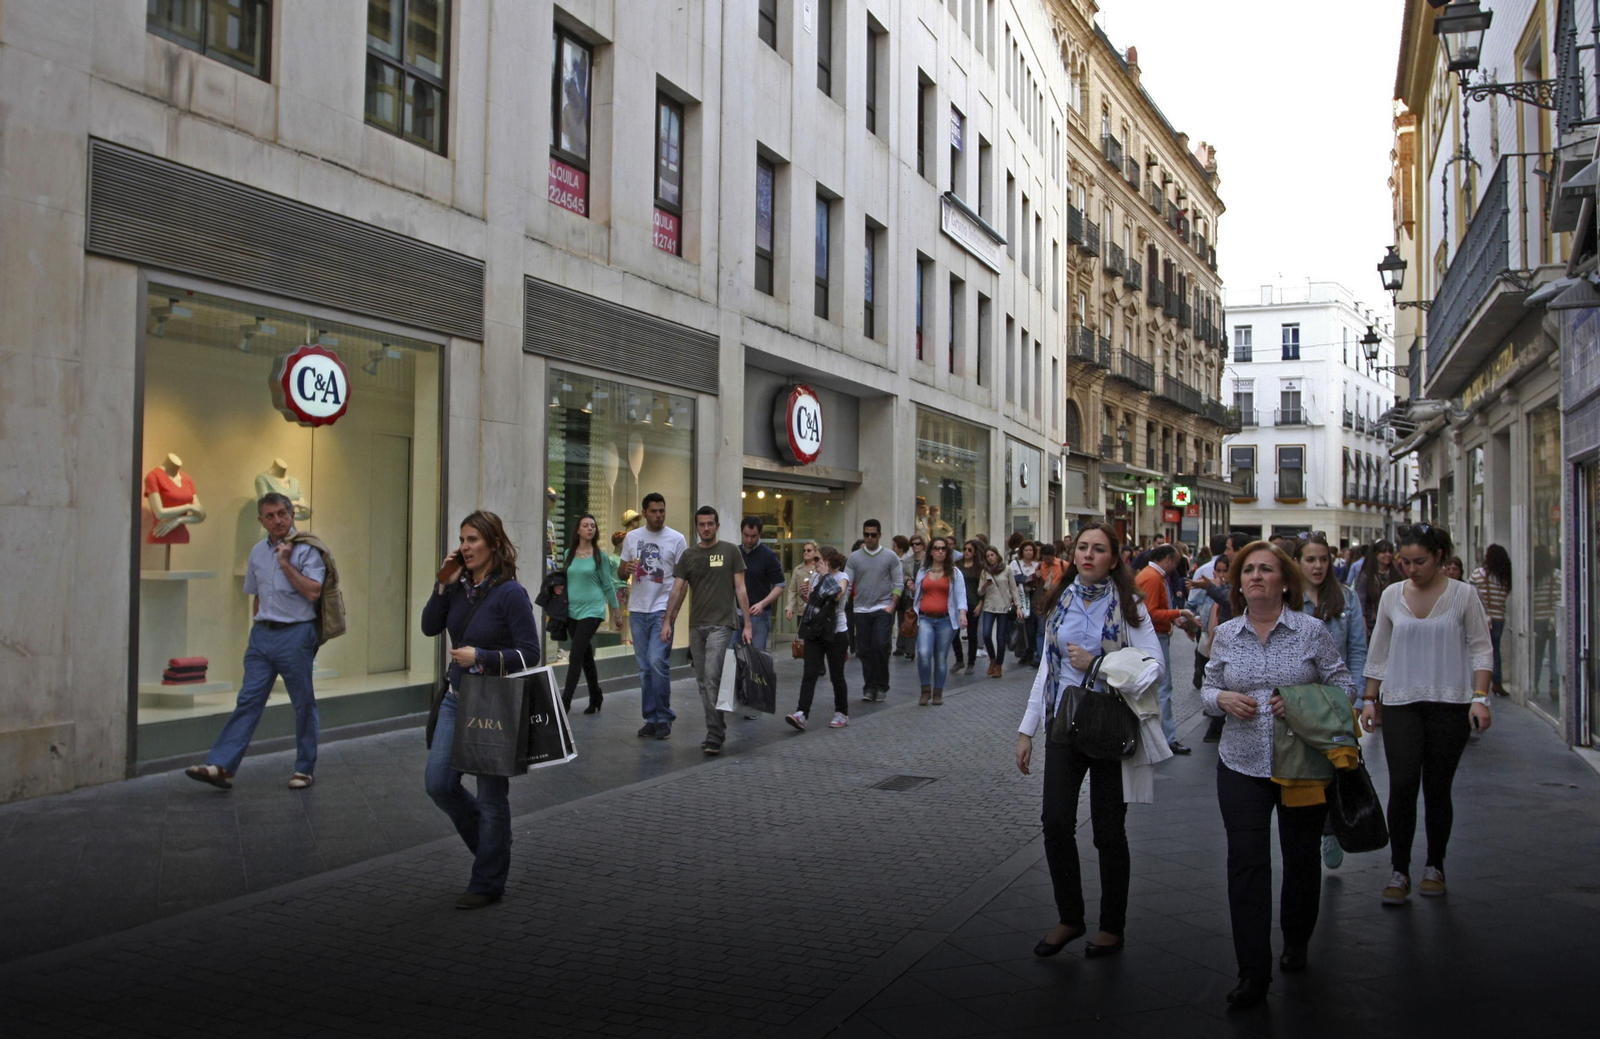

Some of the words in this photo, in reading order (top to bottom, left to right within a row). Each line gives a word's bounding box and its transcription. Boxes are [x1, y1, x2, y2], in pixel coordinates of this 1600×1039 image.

[549, 185, 585, 214] 224545
[297, 366, 341, 405] C&A
[797, 405, 819, 442] C&A
[467, 717, 502, 731] ZARA
